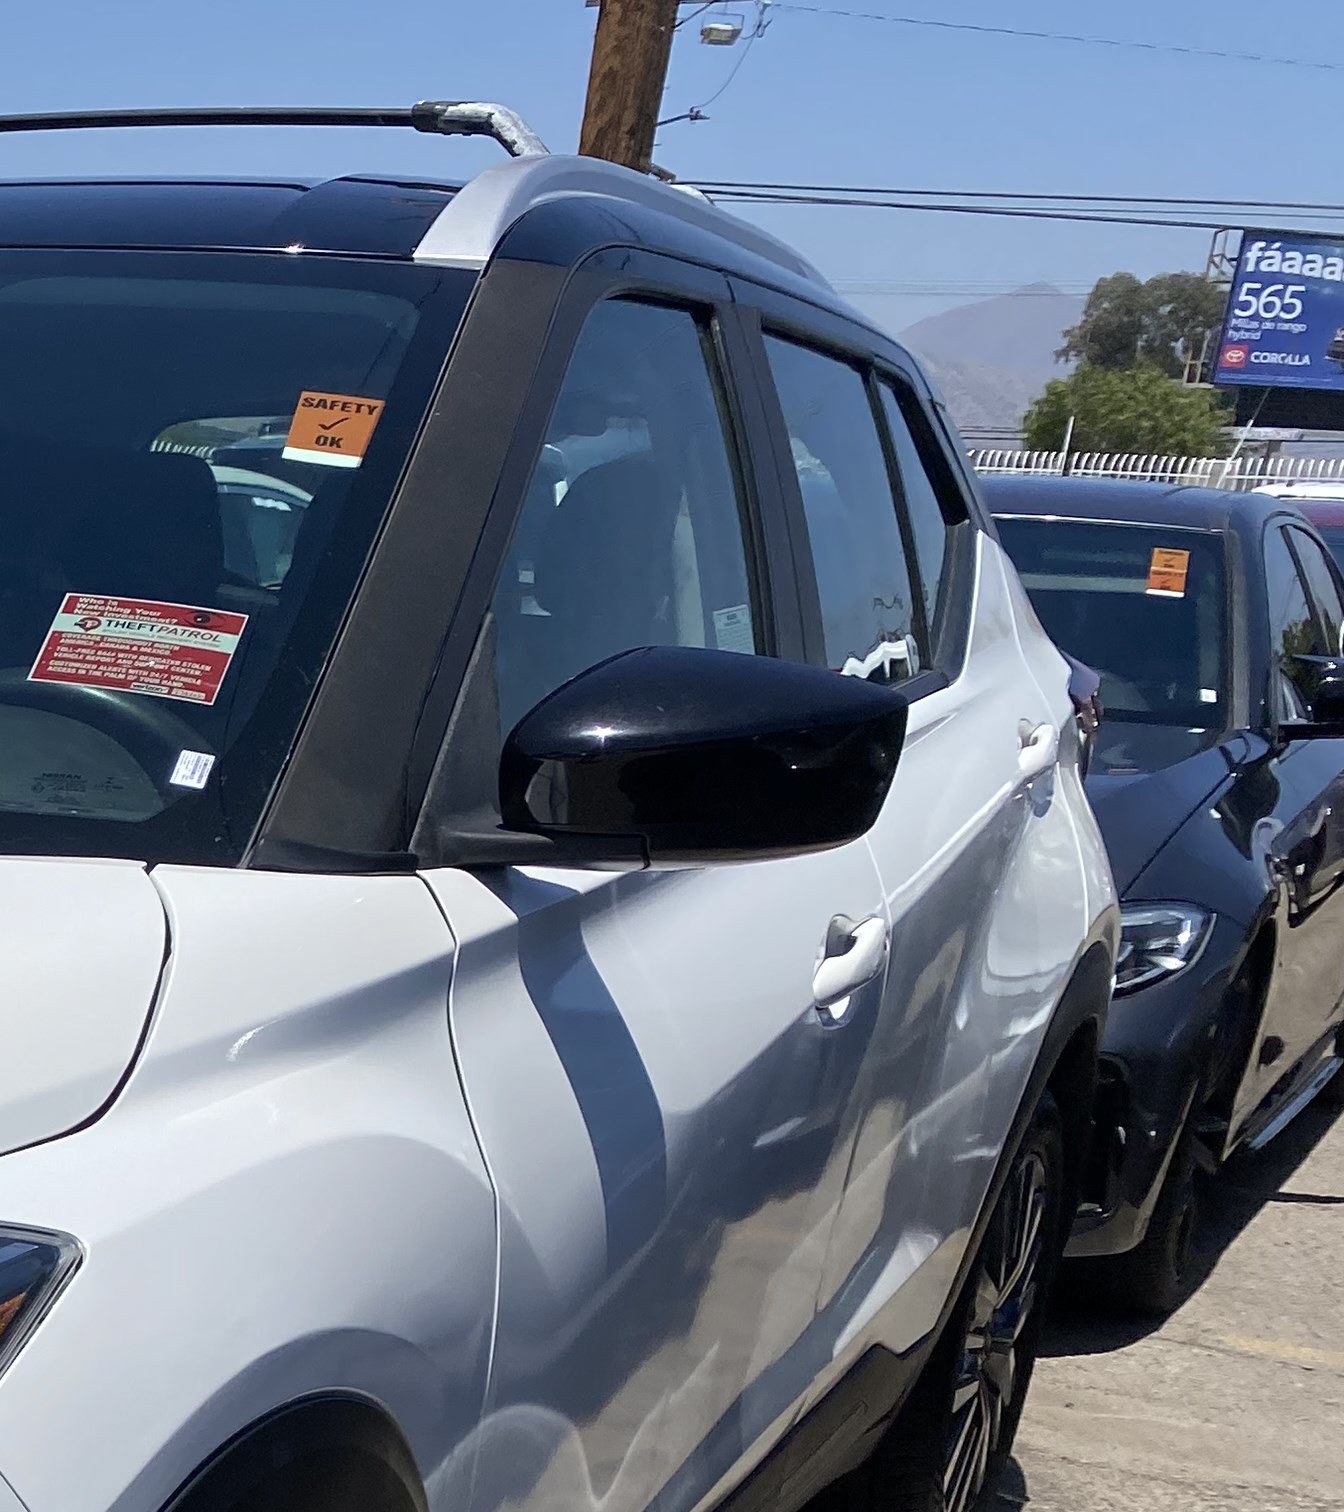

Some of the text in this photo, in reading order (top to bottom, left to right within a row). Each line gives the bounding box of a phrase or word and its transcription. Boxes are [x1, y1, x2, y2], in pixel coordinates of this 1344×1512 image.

[1246, 241, 1344, 282] fáaaa
[1234, 282, 1306, 320] 565
[1228, 329, 1262, 341] hybrid
[301, 397, 379, 415] SAFETY
[315, 434, 343, 449] OK
[78, 596, 105, 605] Who
[73, 607, 100, 615] New
[75, 601, 161, 616] Watching Your
[103, 619, 224, 642] THEFTPATROL
